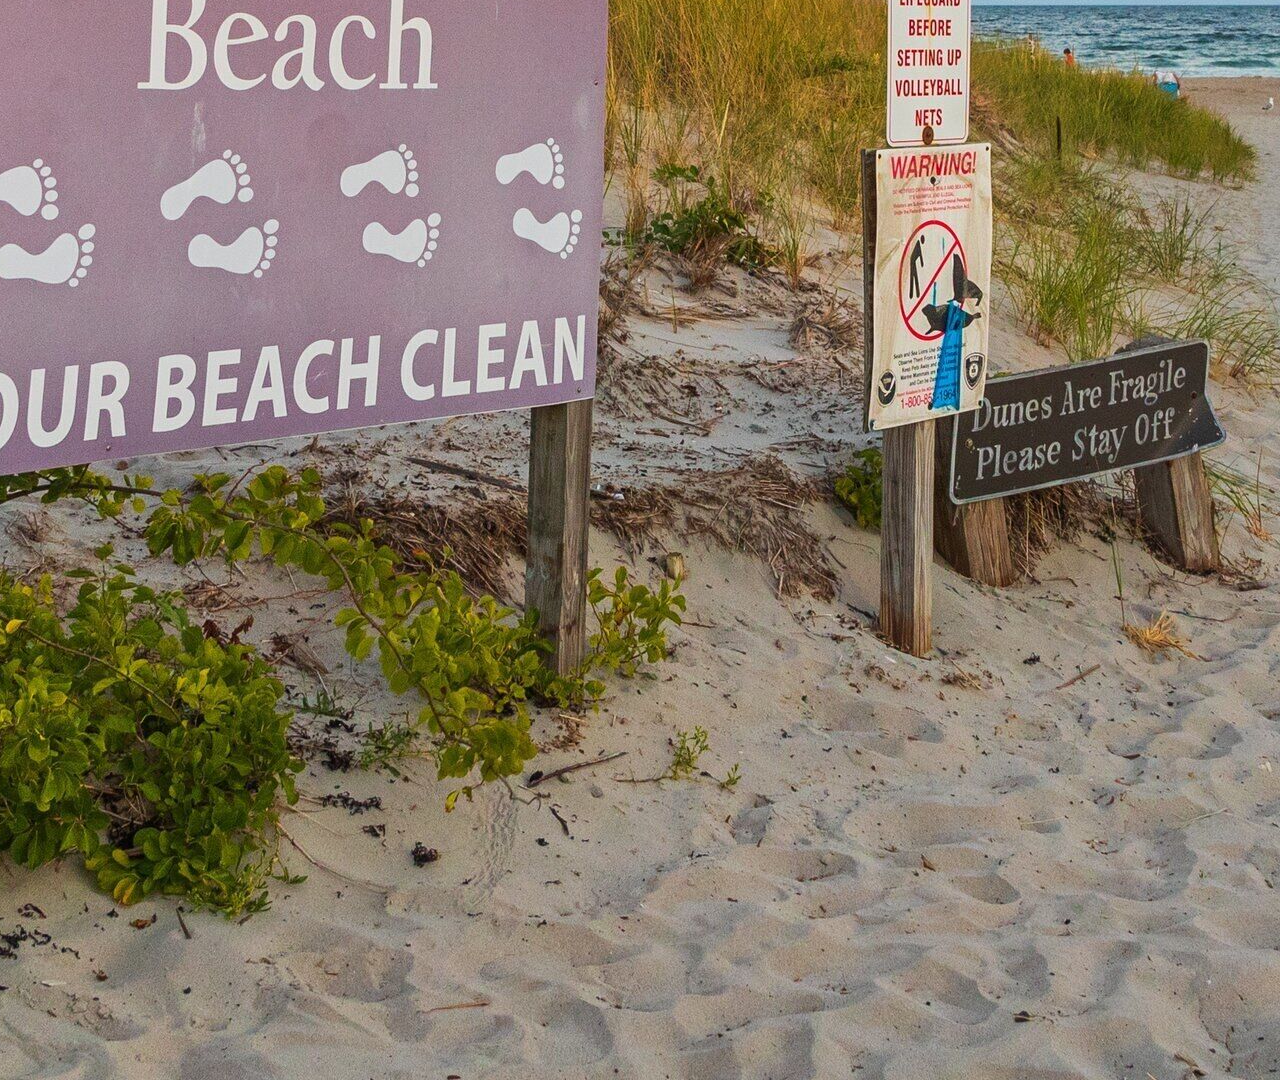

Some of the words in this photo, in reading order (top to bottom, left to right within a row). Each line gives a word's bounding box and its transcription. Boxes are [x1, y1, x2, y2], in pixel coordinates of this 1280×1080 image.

[909, 19, 952, 36] BEFORE
[897, 49, 943, 67] SETTING
[947, 48, 961, 66] UP
[895, 79, 962, 97] VOLLEYBALL
[915, 108, 942, 127] NETS
[891, 151, 976, 179] WARNING!
[151, 335, 380, 433] BEACH
[399, 314, 586, 402] CLEAN
[972, 394, 1052, 433] Dunes
[1060, 381, 1101, 416] Are
[1108, 358, 1186, 405] Fragile
[975, 440, 1062, 481] Please
[1072, 424, 1128, 463] Stay
[1135, 407, 1175, 446] Off
